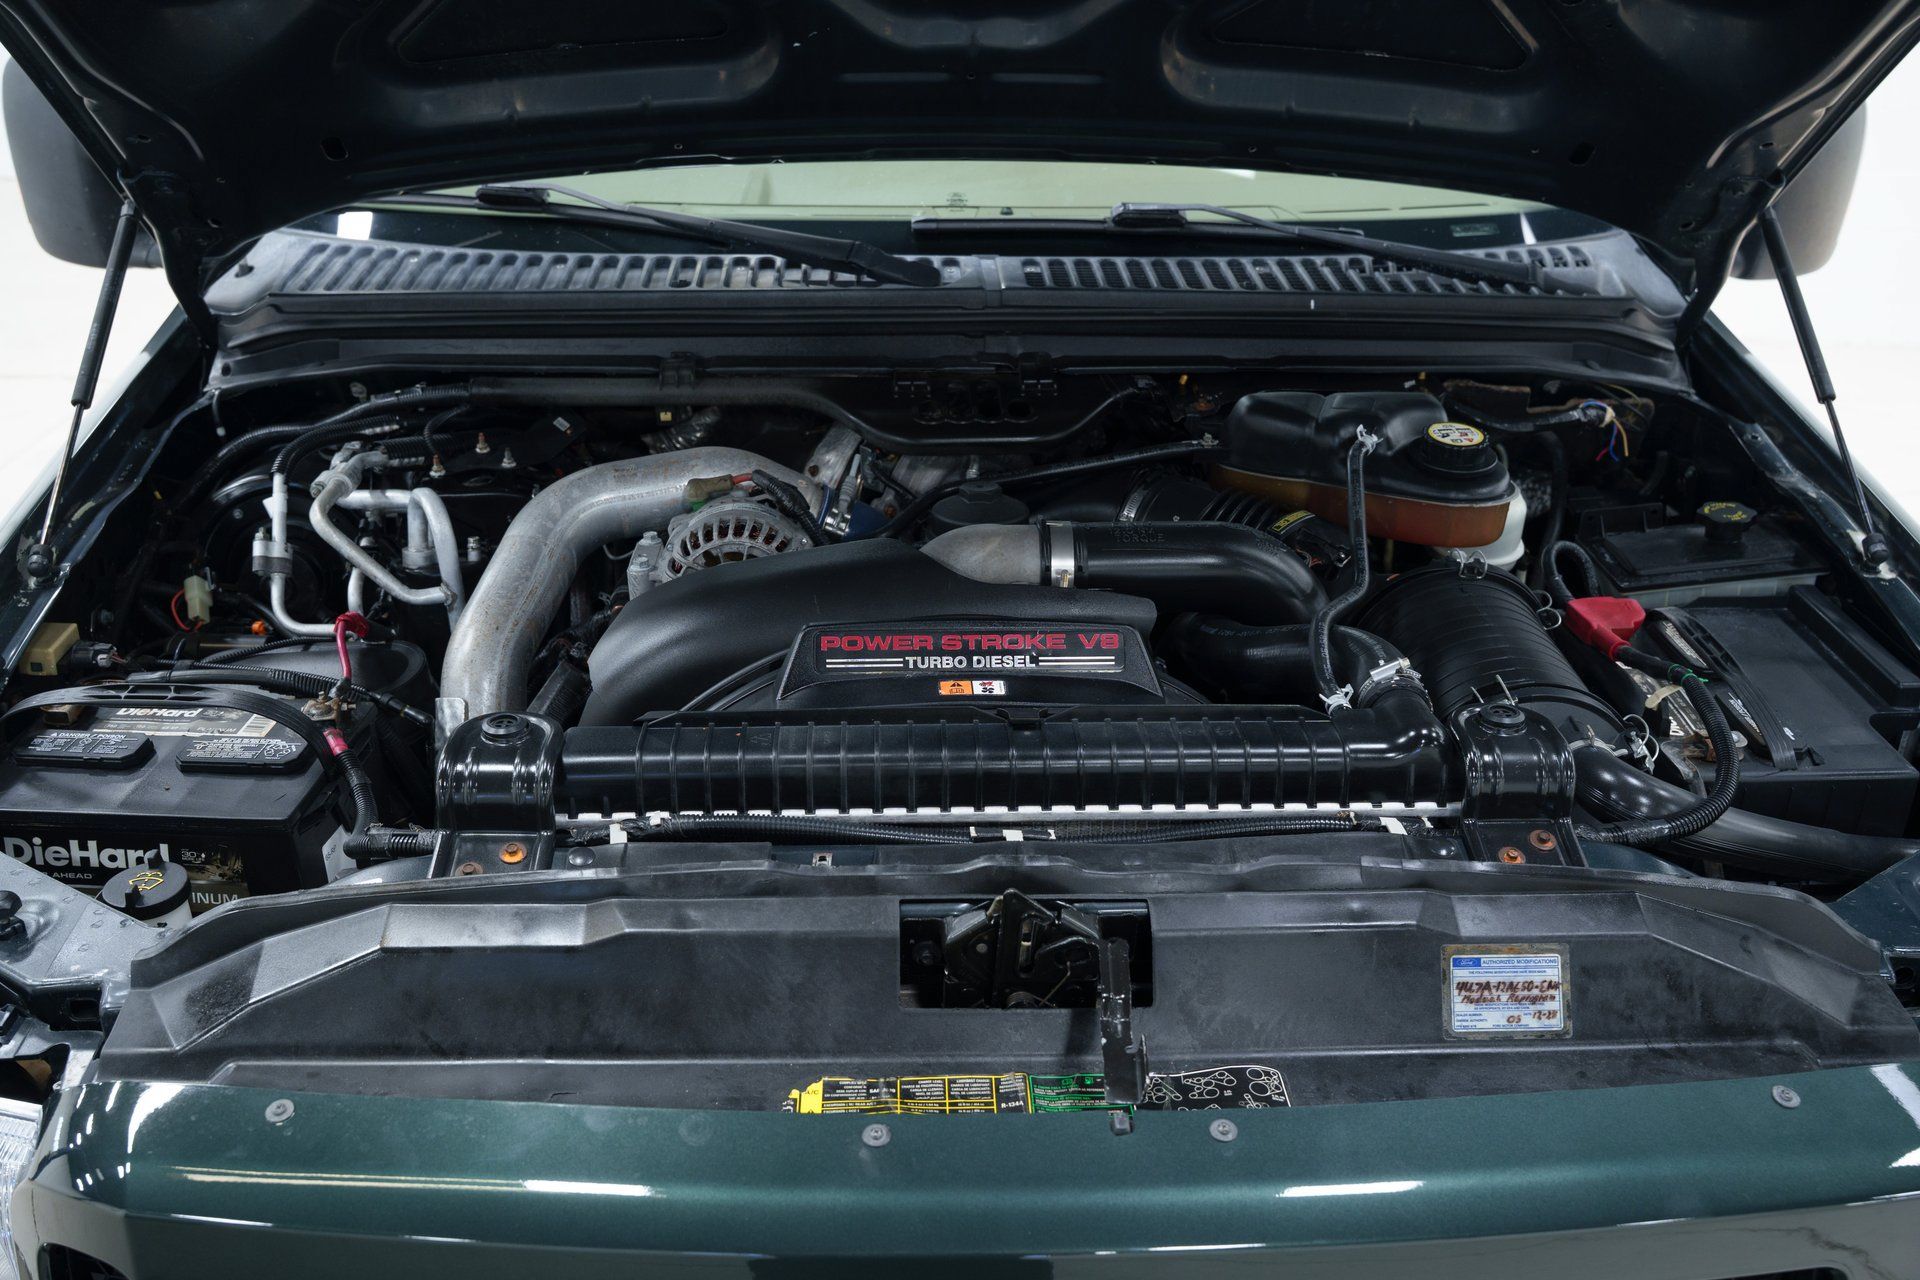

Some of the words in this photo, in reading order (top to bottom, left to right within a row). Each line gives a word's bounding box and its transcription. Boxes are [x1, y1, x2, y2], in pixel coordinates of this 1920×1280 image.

[820, 634, 934, 652] POWER
[941, 633, 1067, 651] STROKE
[1077, 633, 1120, 650] V8
[905, 655, 970, 669] TURBO
[972, 655, 1036, 669] DIESEL
[3, 836, 170, 869] DieHard
[52, 872, 93, 880] AHEAD
[192, 892, 239, 905] INUM
[1000, 1100, 1024, 1109] R-134A
